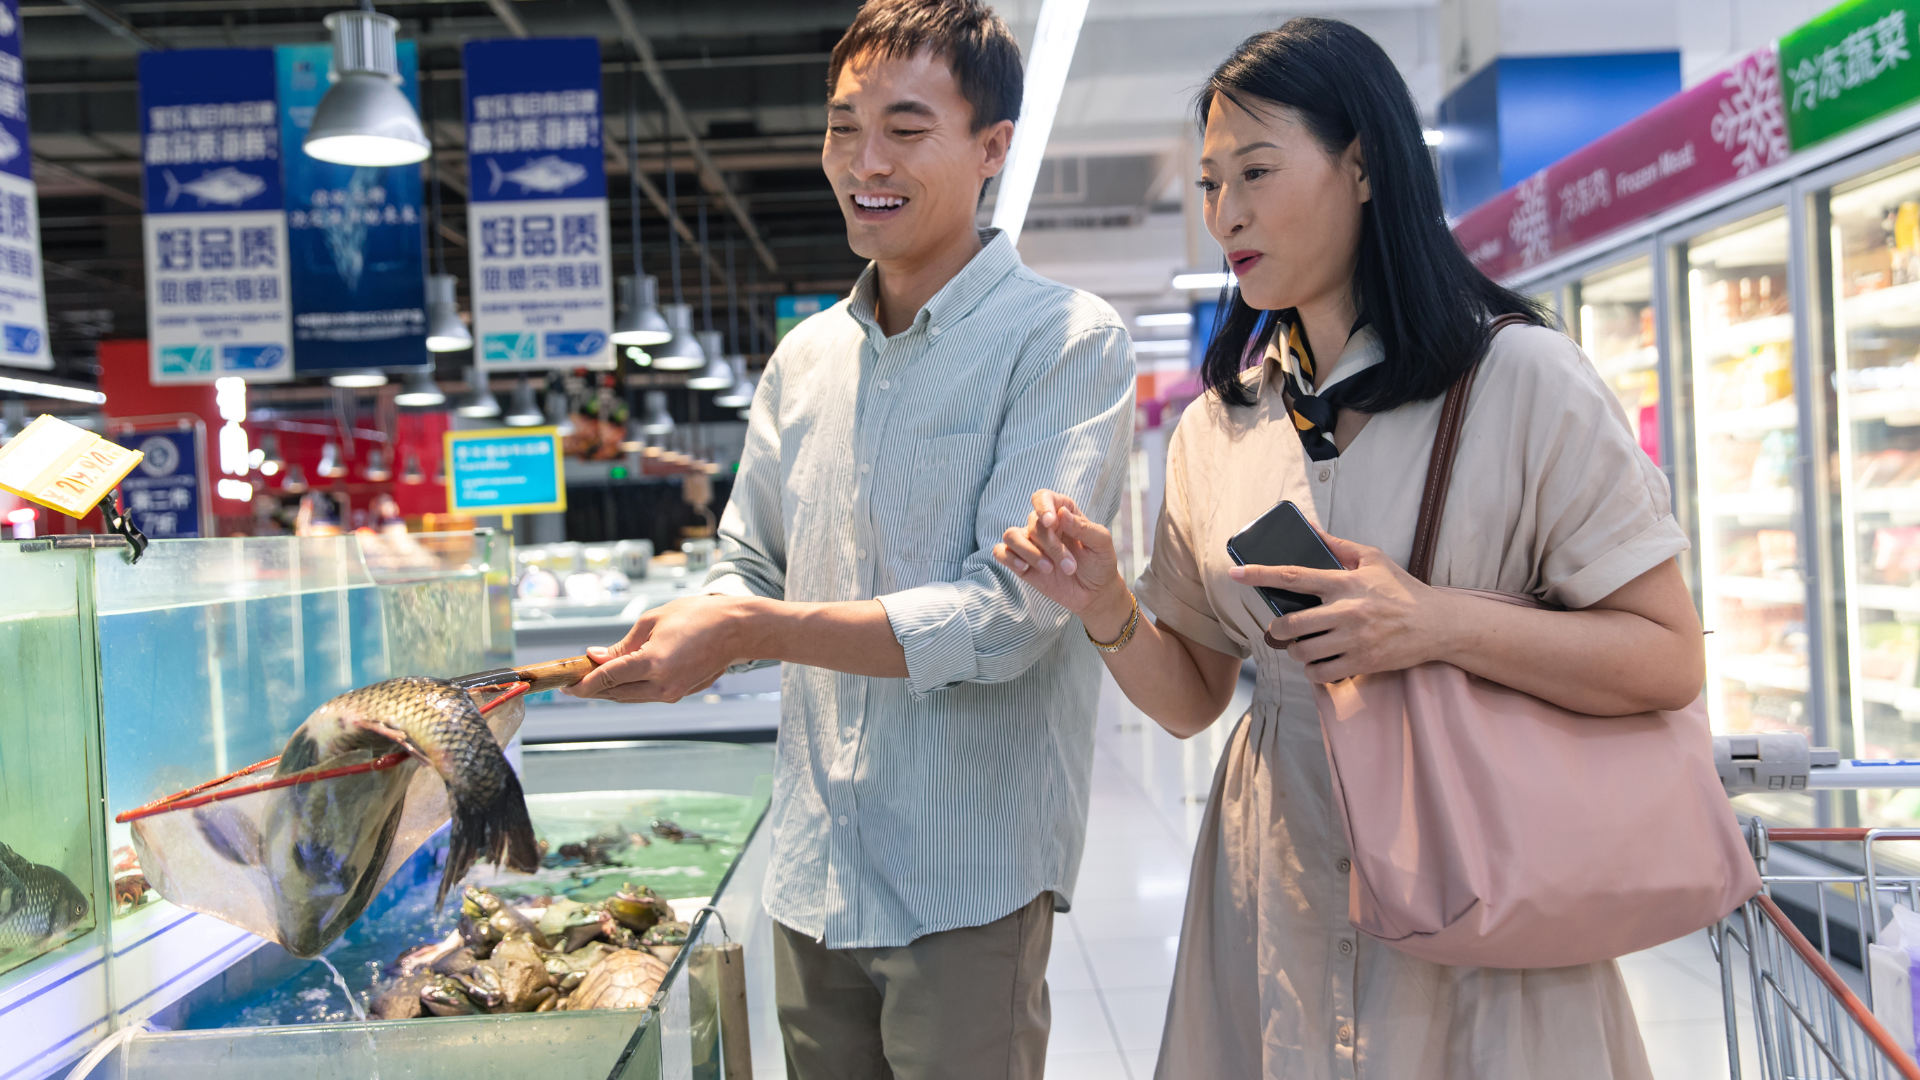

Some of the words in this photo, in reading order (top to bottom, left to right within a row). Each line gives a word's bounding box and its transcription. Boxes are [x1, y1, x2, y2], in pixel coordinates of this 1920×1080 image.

[1787, 9, 1911, 113] 冷冻蔬菜
[1558, 168, 1611, 223] 冷冻肉
[1616, 162, 1658, 197] Frozen
[1659, 140, 1695, 177] Meat
[157, 225, 278, 271] 好品质
[481, 213, 598, 258] 好品质
